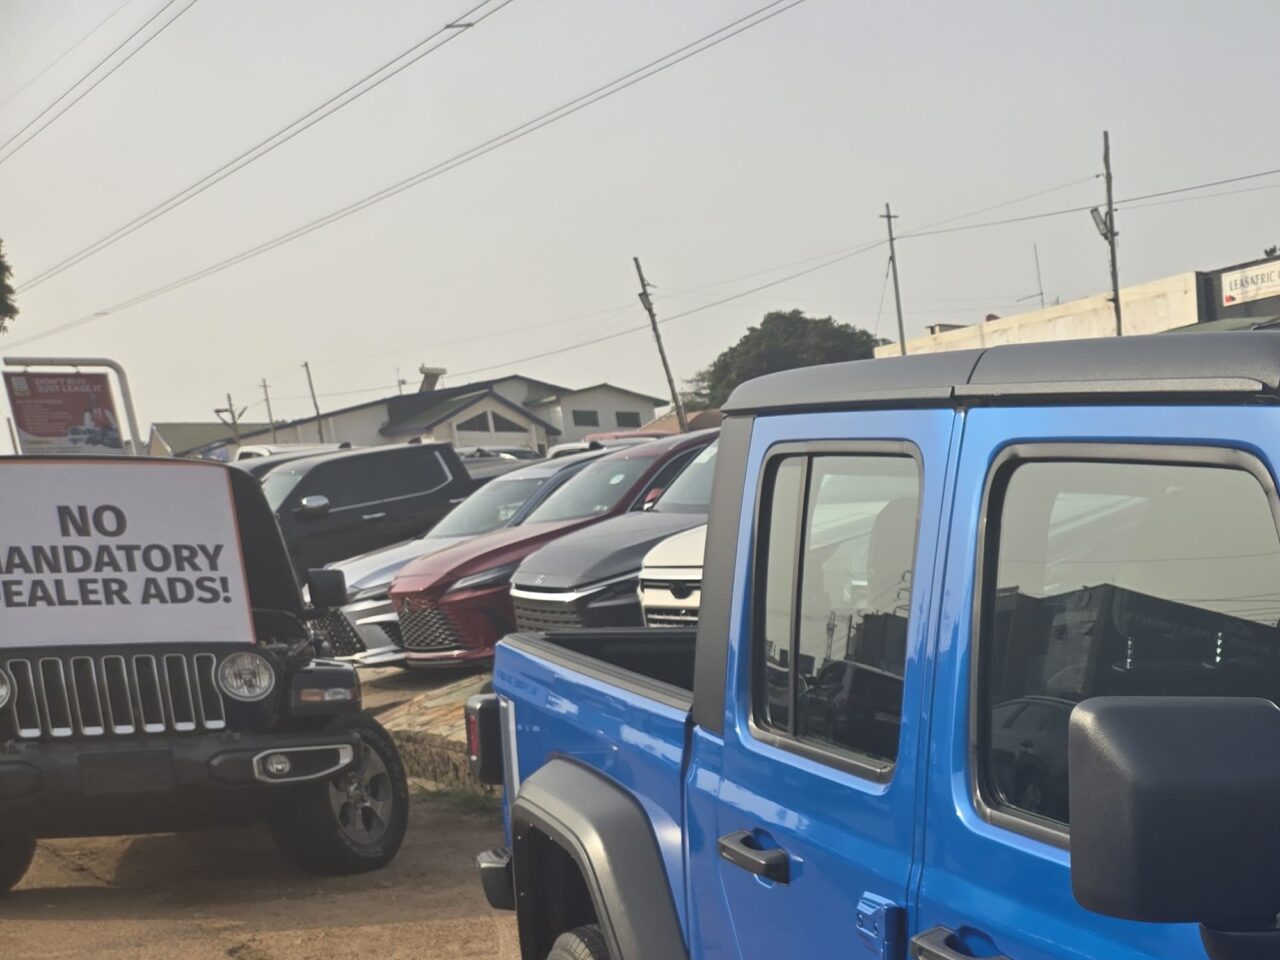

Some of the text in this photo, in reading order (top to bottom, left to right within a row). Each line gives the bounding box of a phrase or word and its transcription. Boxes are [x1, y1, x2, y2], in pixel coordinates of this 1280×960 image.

[1230, 270, 1276, 291] LEASAFRIC
[57, 504, 127, 537] NO
[0, 544, 224, 574] ANDATORY
[0, 576, 232, 608] EALER ADS!
